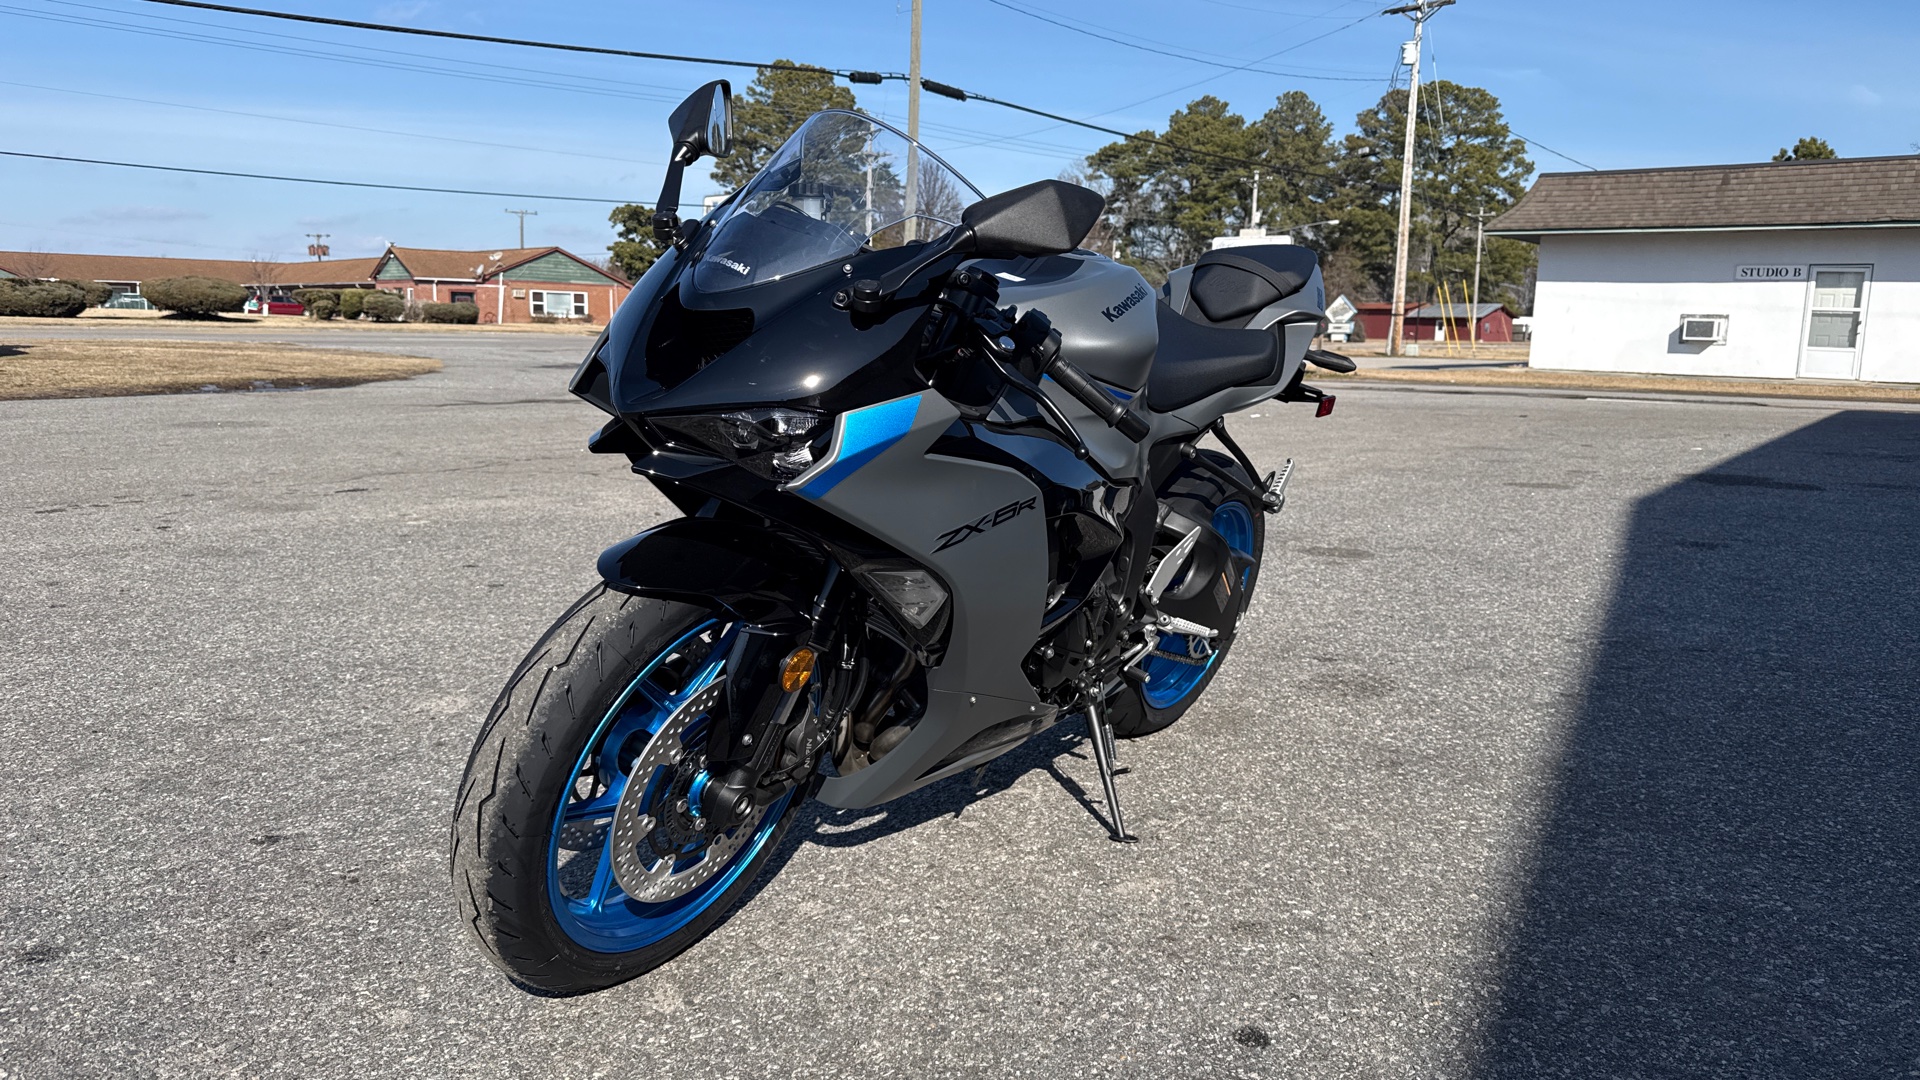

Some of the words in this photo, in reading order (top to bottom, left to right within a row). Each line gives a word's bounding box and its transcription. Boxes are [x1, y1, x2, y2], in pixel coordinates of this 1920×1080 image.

[1740, 267, 1789, 278] STUDIO
[1793, 267, 1802, 278] B
[1101, 283, 1148, 323] Kawasaki
[929, 496, 1037, 555] ZX-6R
[803, 738, 813, 769] NISIN
